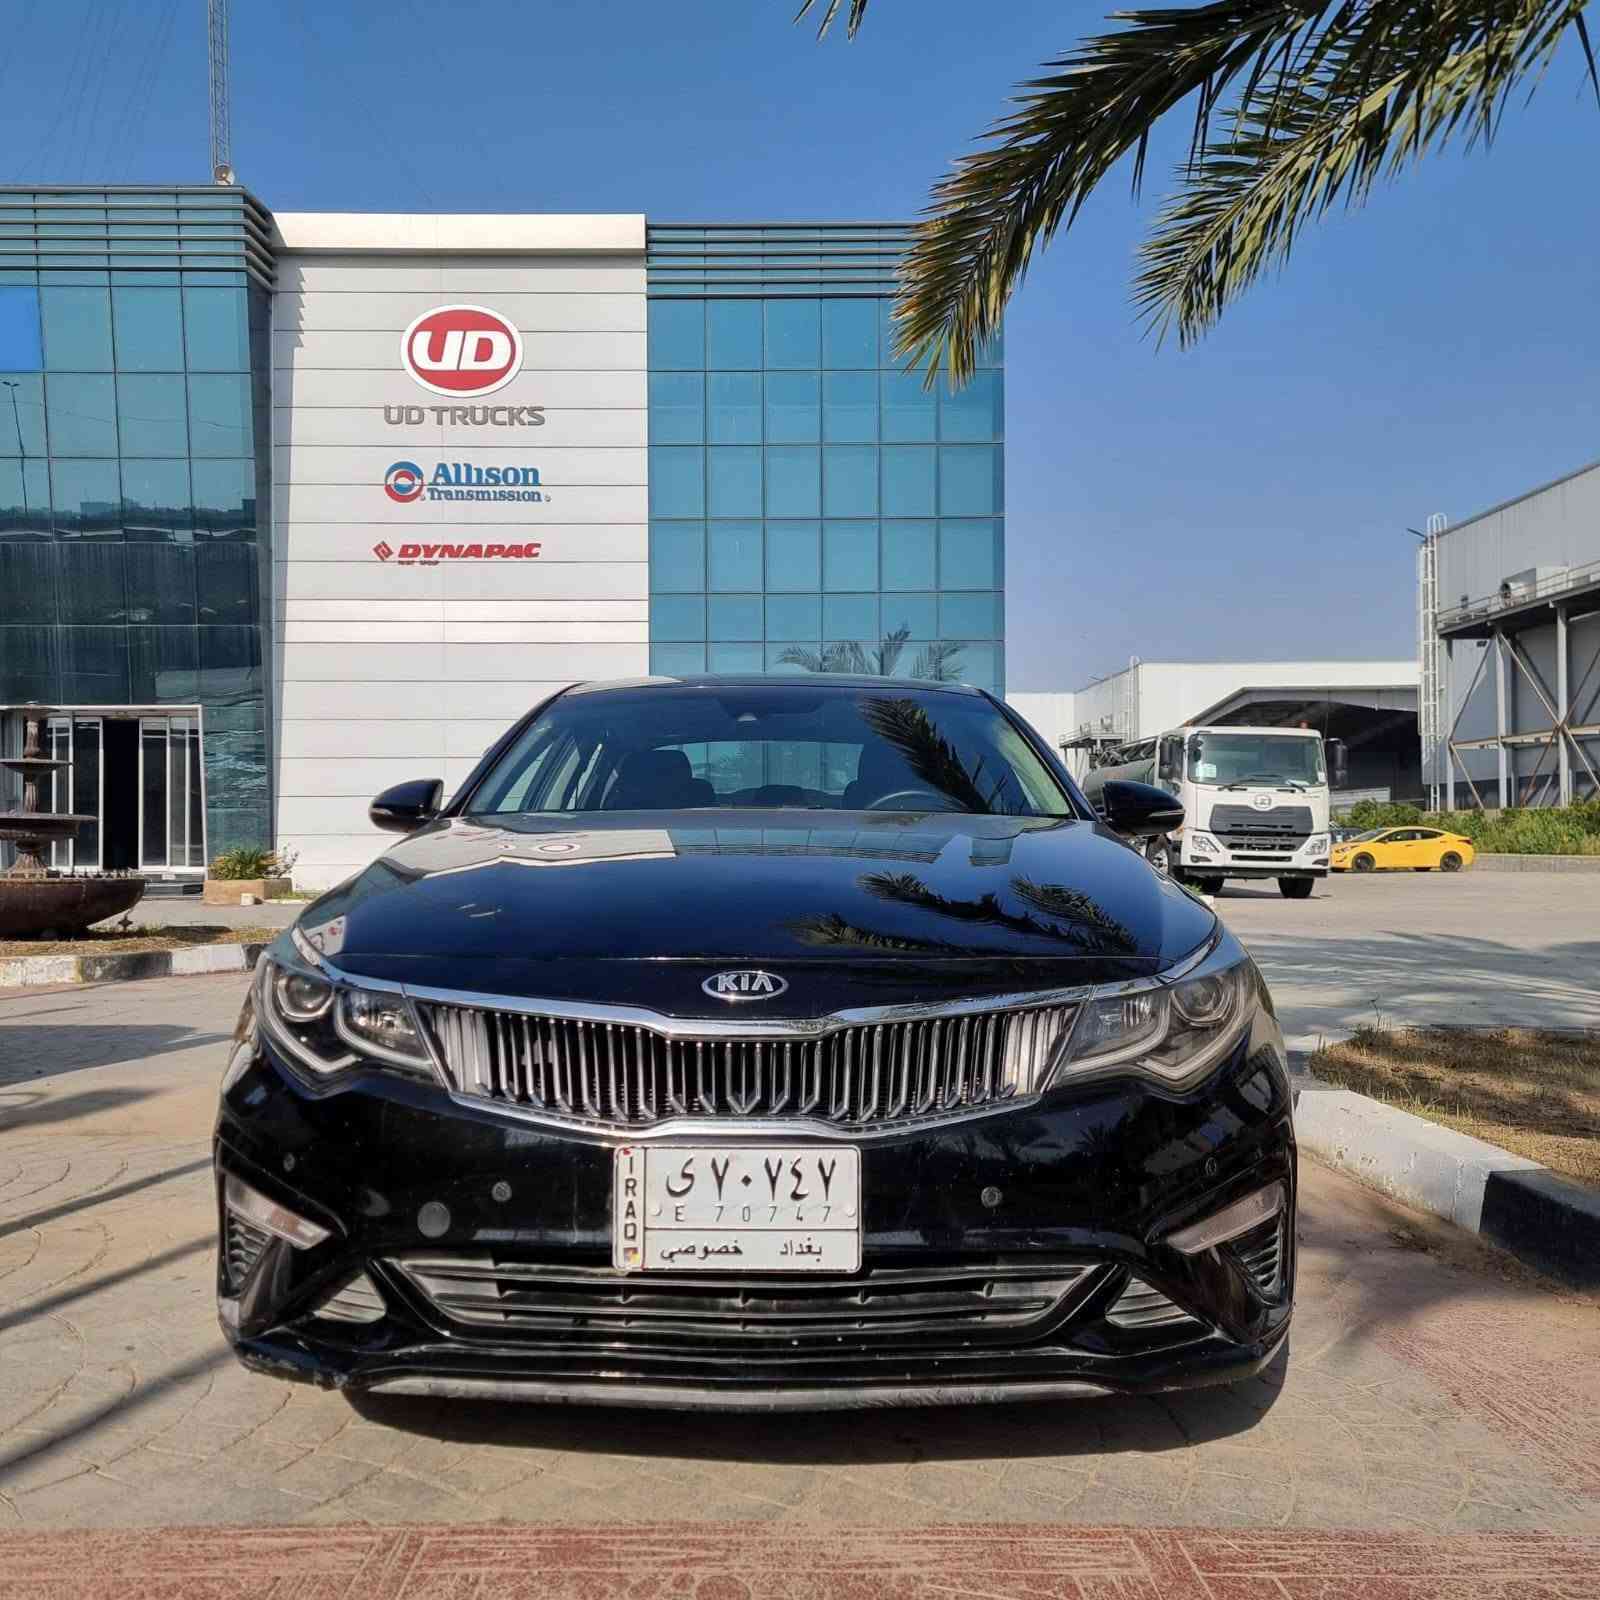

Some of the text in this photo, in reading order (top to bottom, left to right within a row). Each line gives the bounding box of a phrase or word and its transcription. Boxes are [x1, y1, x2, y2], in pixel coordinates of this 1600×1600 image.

[412, 331, 512, 371] UD
[384, 405, 545, 426] UD TRUCKS
[429, 462, 542, 486] Allison
[427, 487, 543, 502] Transmission
[398, 543, 541, 558] DYNAPAC
[717, 974, 774, 992] KIA
[624, 1157, 637, 1240] IRAQ
[660, 1237, 822, 1262] بغداد خصوصي
